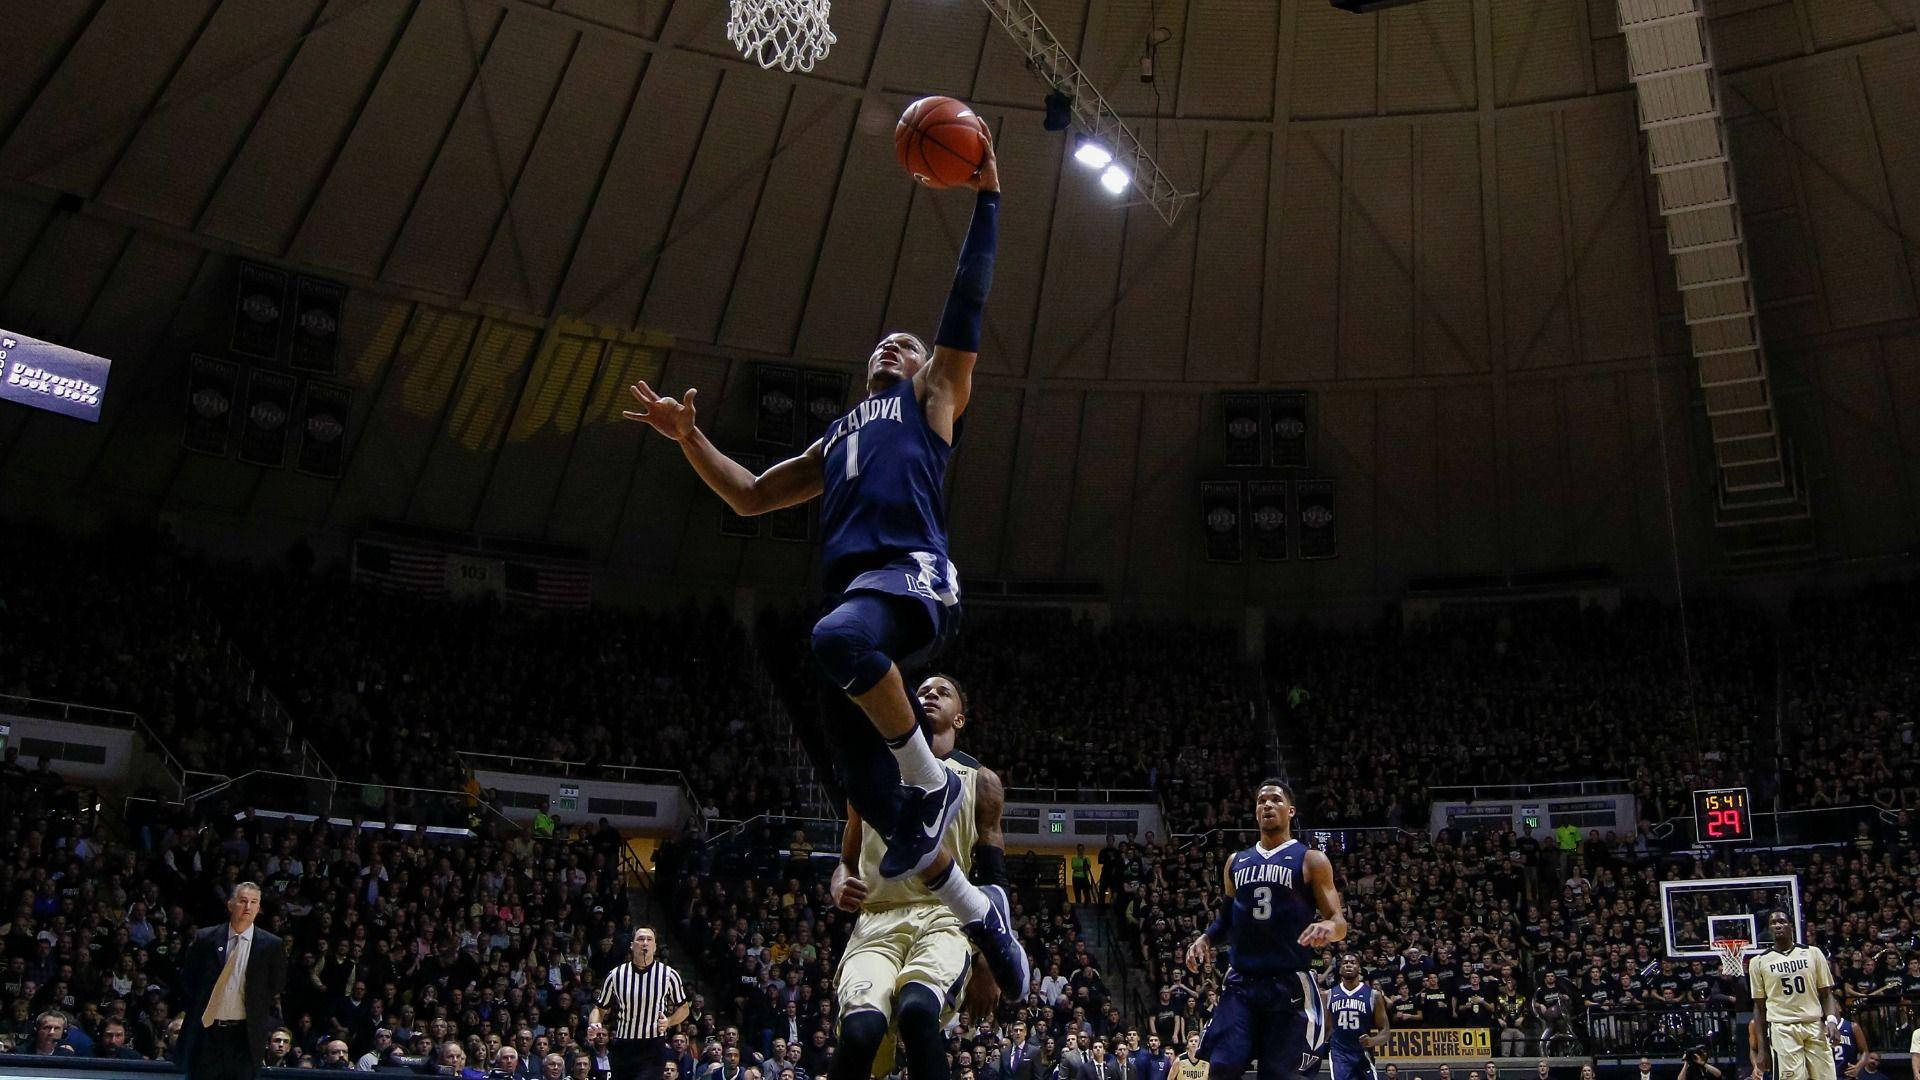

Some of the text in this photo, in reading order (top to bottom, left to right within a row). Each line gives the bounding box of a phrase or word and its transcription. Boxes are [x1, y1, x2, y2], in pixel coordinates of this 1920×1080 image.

[3, 338, 16, 348] PF
[14, 362, 100, 395] University
[9, 373, 98, 405] Book Store
[846, 431, 859, 480] 1
[1708, 810, 1741, 836] 29
[1234, 864, 1293, 890] VILLANOVA
[1252, 886, 1272, 920] 3
[1769, 959, 1808, 973] PURDUE
[1781, 976, 1806, 995] 50
[1331, 999, 1367, 1013] VILLANOVA
[1337, 1011, 1360, 1030] 45
[1432, 1030, 1459, 1043] LIVES
[1462, 1031, 1486, 1046] 0 1
[1433, 1043, 1461, 1056] HERE
[1183, 1070, 1205, 1079] PURDUE
